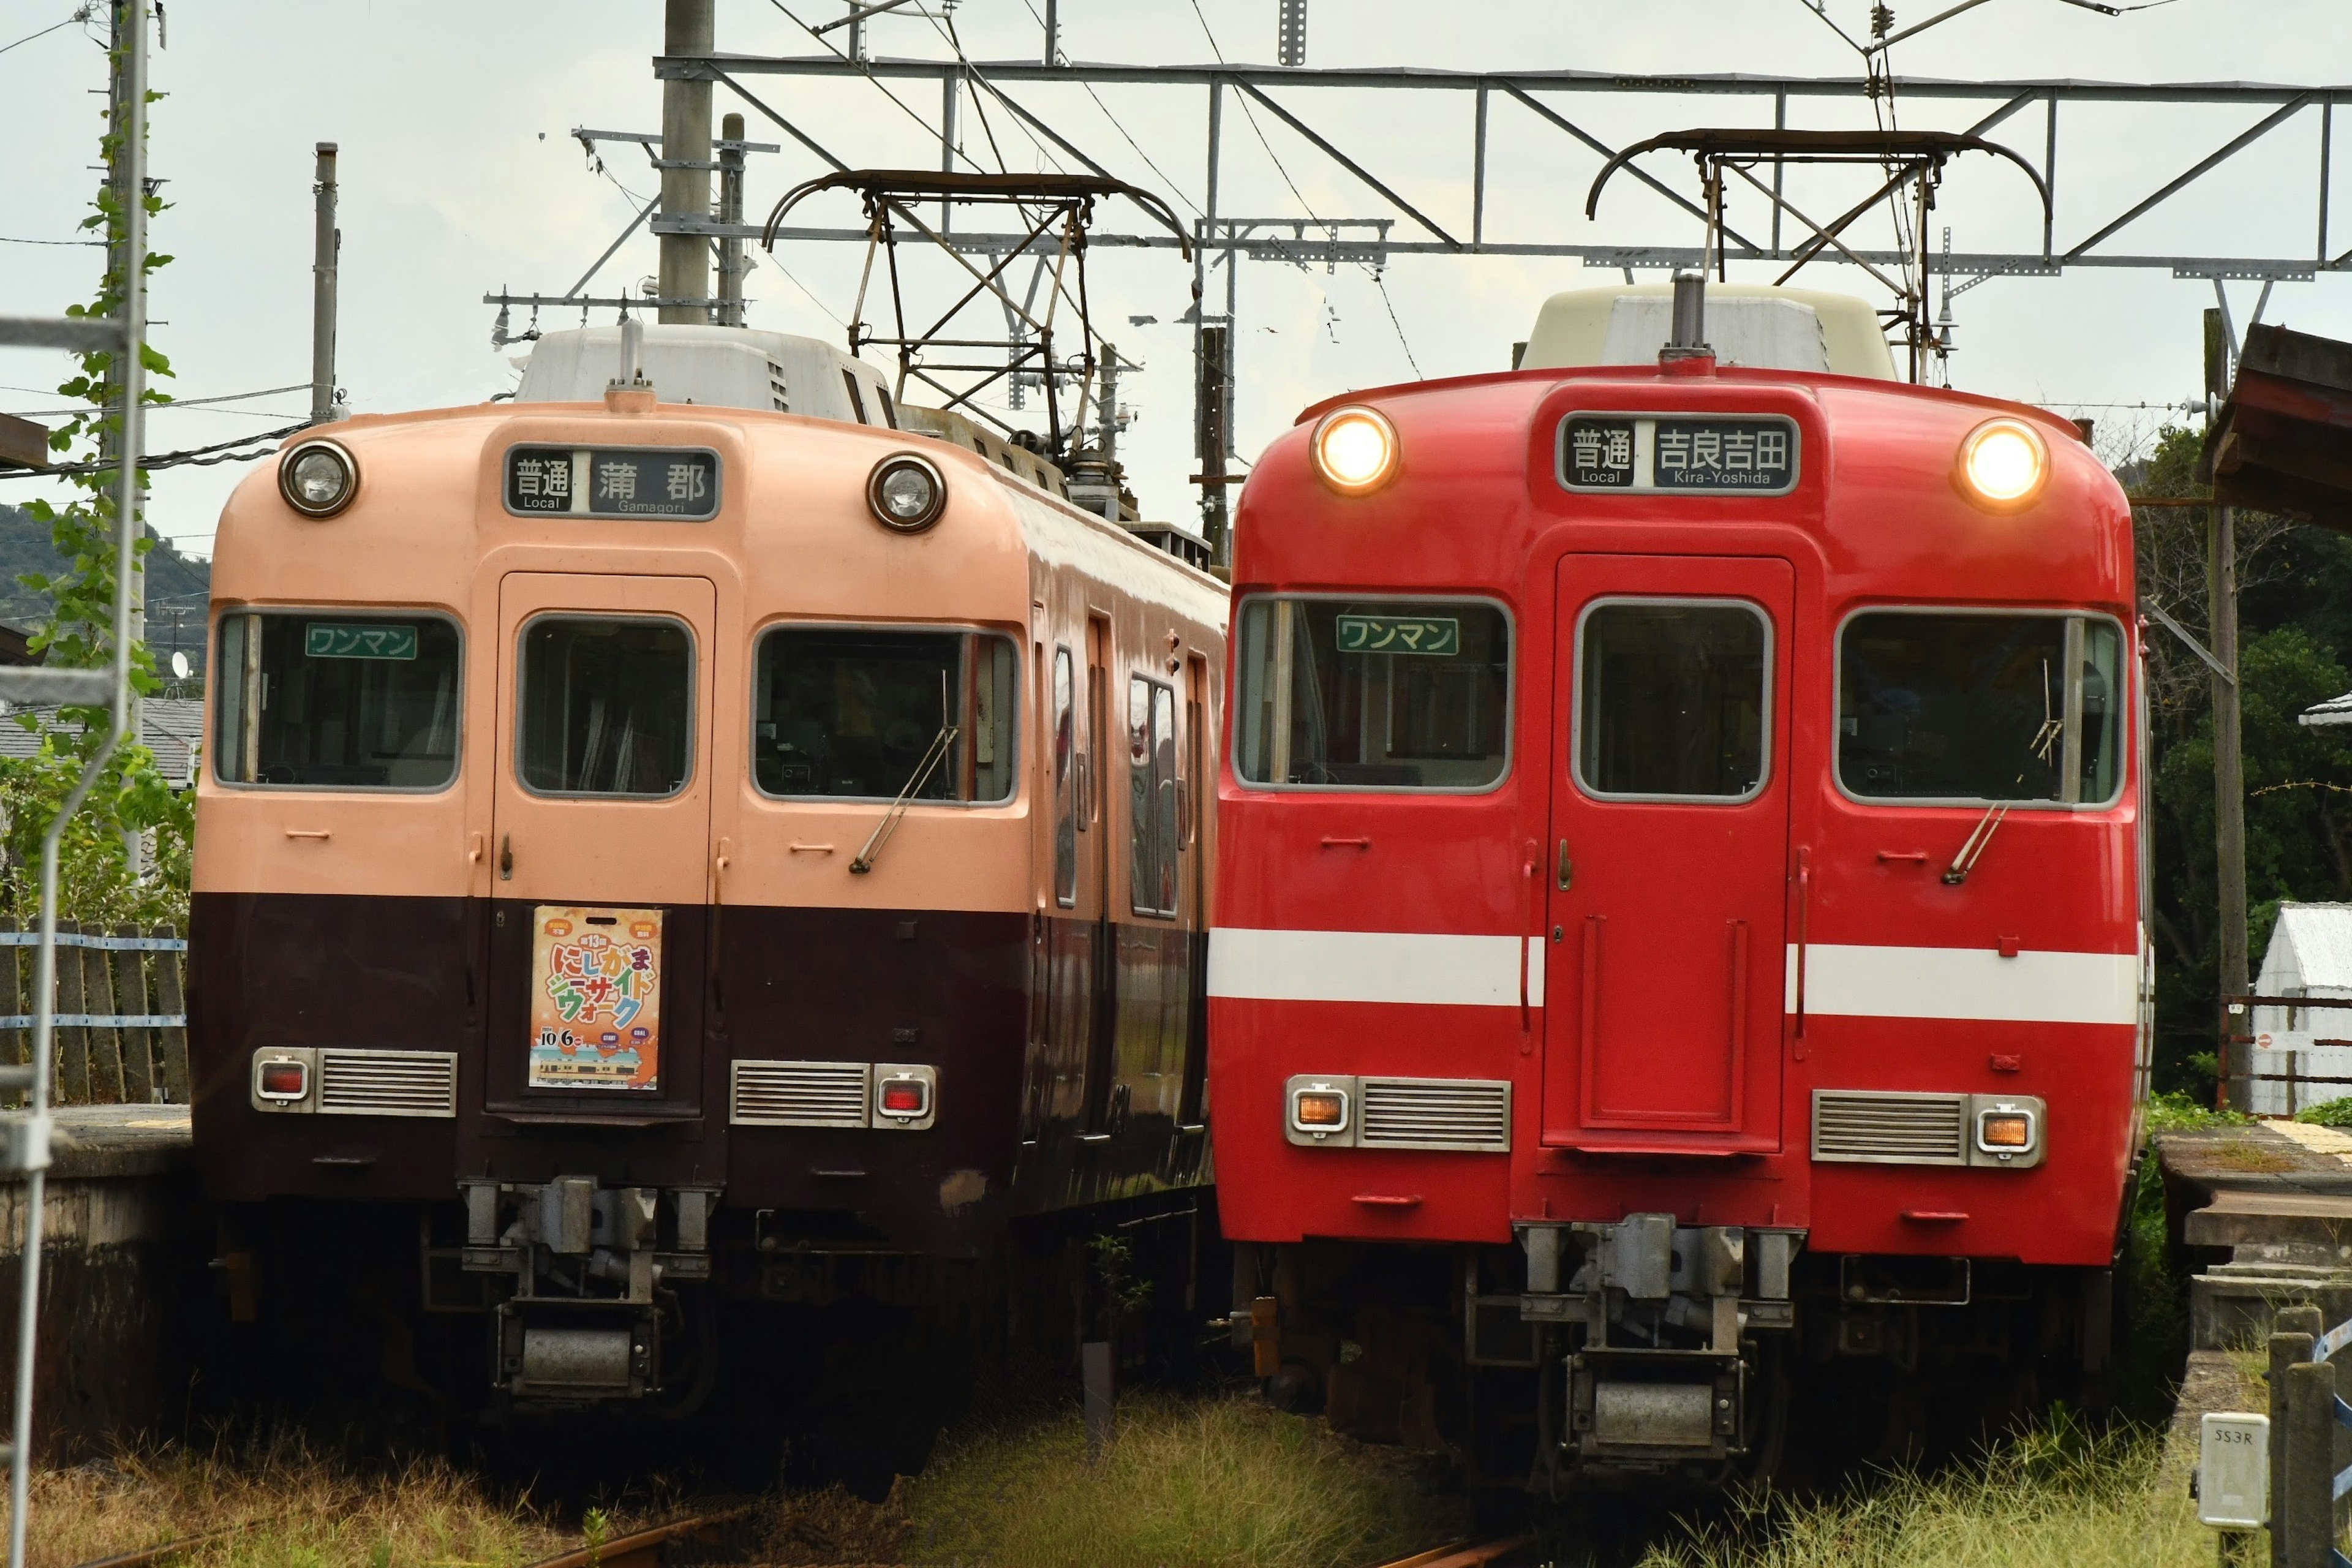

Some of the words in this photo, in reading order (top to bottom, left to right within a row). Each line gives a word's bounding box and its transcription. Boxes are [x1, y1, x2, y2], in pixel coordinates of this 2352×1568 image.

[1573, 428, 1630, 470] 普通
[1659, 428, 1787, 470] 吉良吉田
[516, 459, 568, 497] 普通
[598, 462, 706, 501] 蒲郡
[1581, 470, 1621, 483] Local
[1675, 470, 1771, 484] Kira-Yoshida
[524, 496, 560, 509] Local
[618, 500, 684, 514] Gamagori
[311, 628, 413, 655] ワンマン
[1341, 621, 1452, 650] ワンマン
[553, 945, 651, 976] にしがま
[550, 968, 653, 1003] シーサイド
[2215, 1429, 2253, 1446] SS3R
